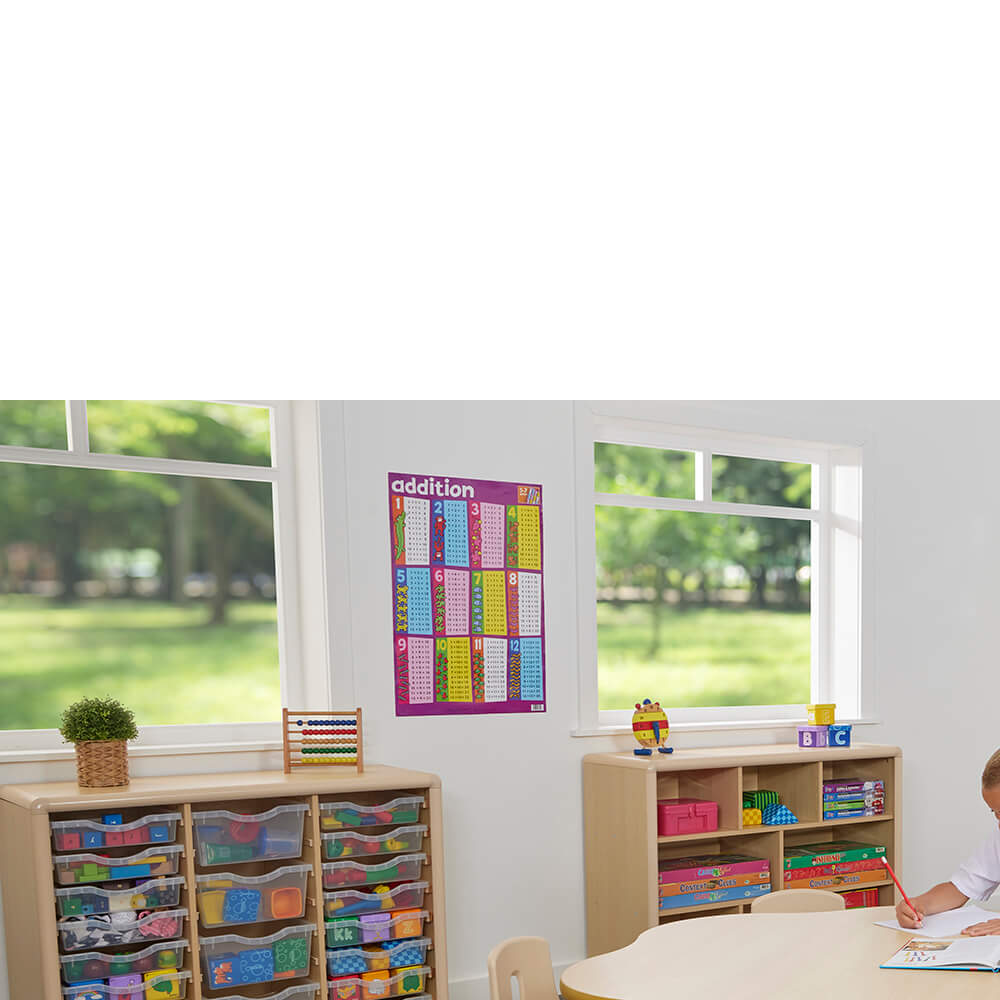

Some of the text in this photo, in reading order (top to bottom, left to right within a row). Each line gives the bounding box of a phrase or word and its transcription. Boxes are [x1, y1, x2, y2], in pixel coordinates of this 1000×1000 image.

[391, 477, 475, 498] addition
[434, 501, 443, 514] 2
[471, 503, 480, 516] 3
[508, 506, 516, 519] 4
[396, 570, 405, 583] 5
[434, 570, 443, 582] 6
[474, 573, 482, 585] 7
[508, 573, 517, 585] 8
[398, 638, 407, 651] 9
[436, 639, 447, 651] 10
[474, 639, 482, 650] 11
[510, 640, 519, 652] 12
[803, 731, 813, 747] B
[835, 730, 847, 746] C
